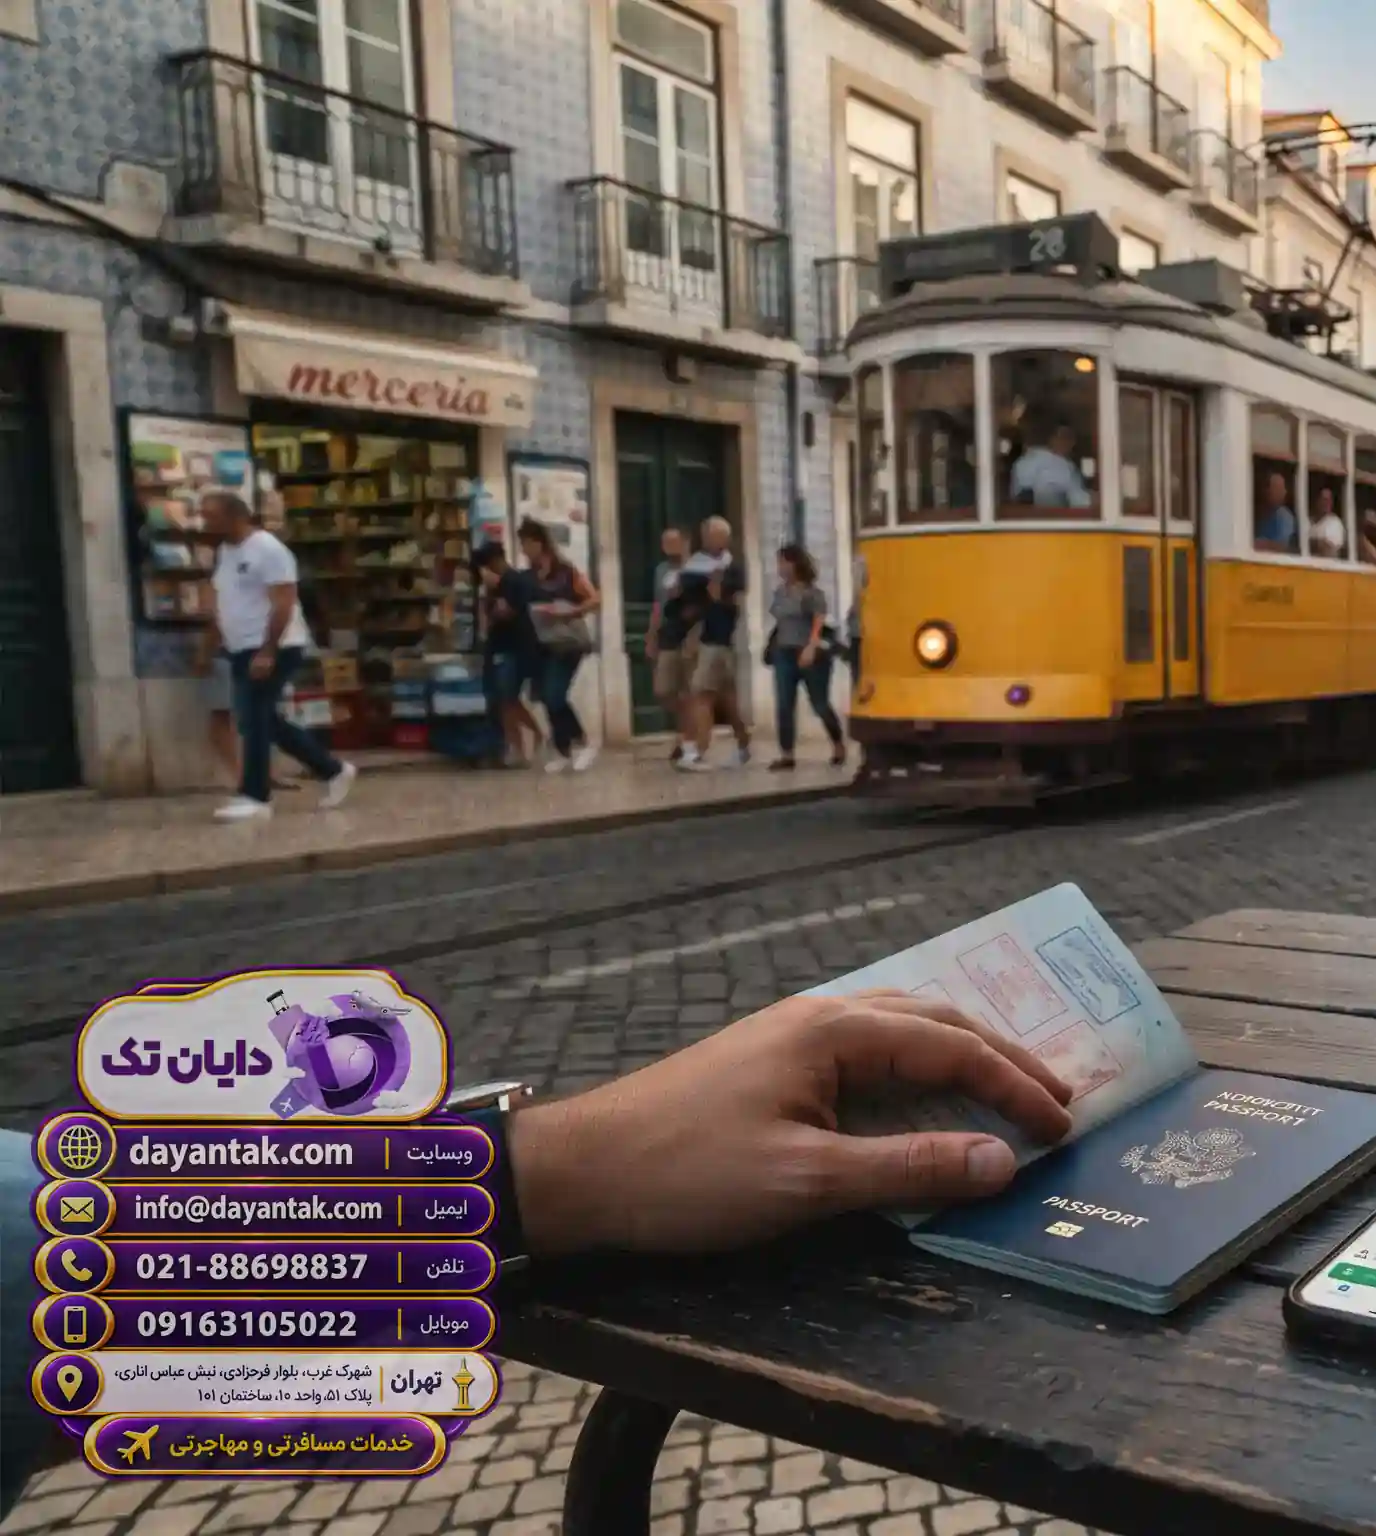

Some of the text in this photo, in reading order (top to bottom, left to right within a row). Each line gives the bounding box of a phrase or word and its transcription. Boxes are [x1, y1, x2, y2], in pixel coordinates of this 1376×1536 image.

[287, 363, 491, 416] merceria
[1203, 1100, 1306, 1127] PASSPORT
[1042, 1196, 1150, 1228] PASSPORT
